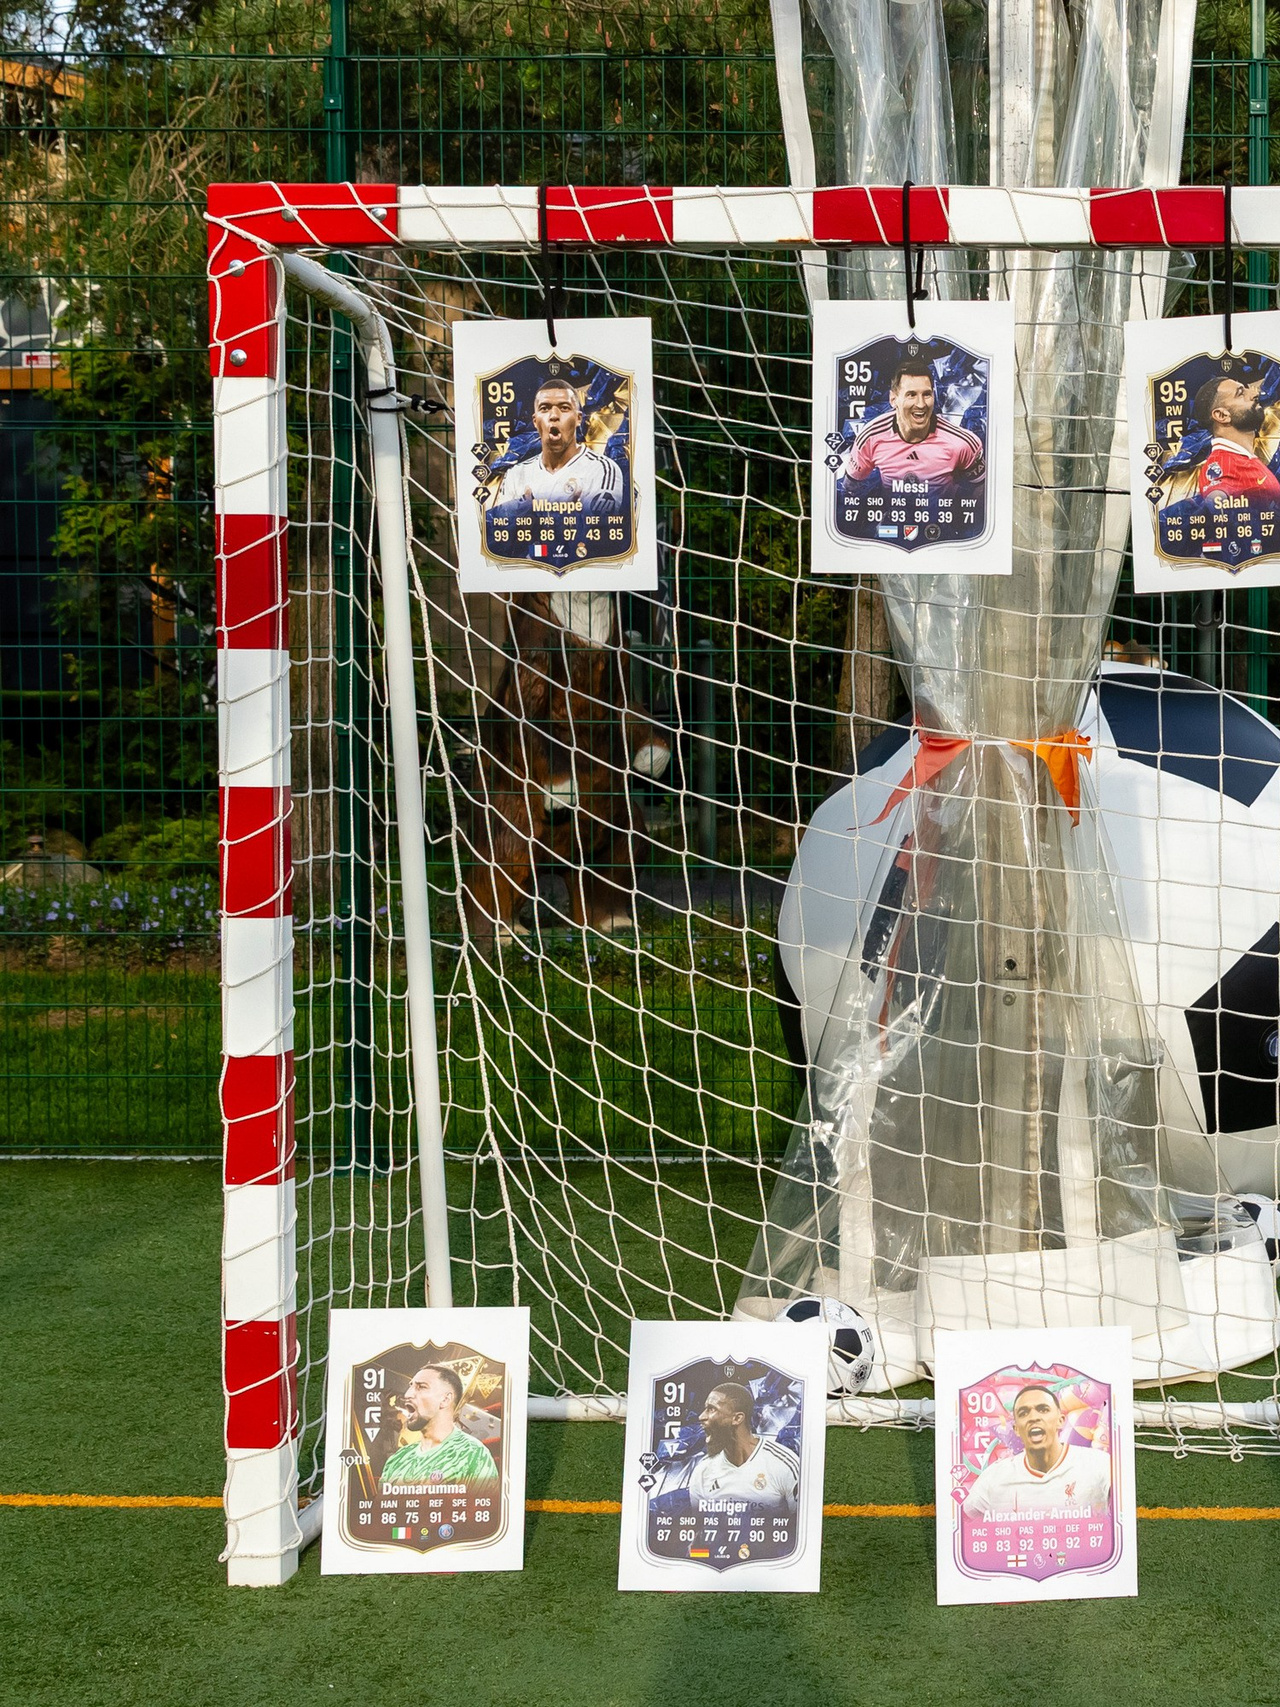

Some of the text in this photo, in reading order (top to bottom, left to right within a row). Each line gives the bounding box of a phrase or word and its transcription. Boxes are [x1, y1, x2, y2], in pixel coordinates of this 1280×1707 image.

[844, 361, 872, 382] 95
[488, 382, 515, 404] 95
[849, 385, 866, 396] RW
[1160, 380, 1187, 403] 95
[496, 406, 508, 417] ST
[1166, 405, 1183, 416] RW
[892, 480, 928, 493] Messi
[533, 499, 582, 513] Mbappé
[844, 497, 976, 507] PAC SHO PAS DRI DEF PHY
[1214, 495, 1249, 509] Salah
[494, 515, 624, 525] PAC SHO PAS DRI DEF PHY
[845, 510, 974, 523] 87 90 93 96 39 71
[1167, 516, 1182, 525] PAC
[1190, 515, 1206, 525] SHO
[1214, 513, 1228, 523] PAS
[1238, 512, 1251, 521] DRI
[1261, 511, 1275, 520] DEF
[494, 529, 623, 542] 99 95 86 97 43 85
[1167, 529, 1182, 541] 96
[1190, 528, 1206, 540] 94
[1216, 527, 1227, 539] 91
[1237, 525, 1252, 537] 96
[1261, 524, 1274, 536] 57
[363, 1368, 385, 1389] 91
[367, 1392, 381, 1402] GK
[663, 1382, 685, 1404] 91
[967, 1392, 995, 1413] 90
[667, 1406, 681, 1416] CB
[975, 1417, 988, 1426] RB
[383, 1483, 466, 1495] Donnarumma
[359, 1498, 491, 1508] DIV HAN KIC REF SPE POS
[699, 1499, 748, 1515] Rüdiger
[359, 1511, 490, 1524] 91 86 75 91 54 88
[983, 1506, 1092, 1523] Alexander-Arnold
[657, 1517, 789, 1526] PAC SHO PAS DRI DEF PHY
[657, 1531, 787, 1542] 87 60 77 77 90 90
[972, 1523, 1104, 1537] PAC SHO PAS DRI DEF PHY
[972, 1536, 1103, 1553] 89 83 92 90 92 87
